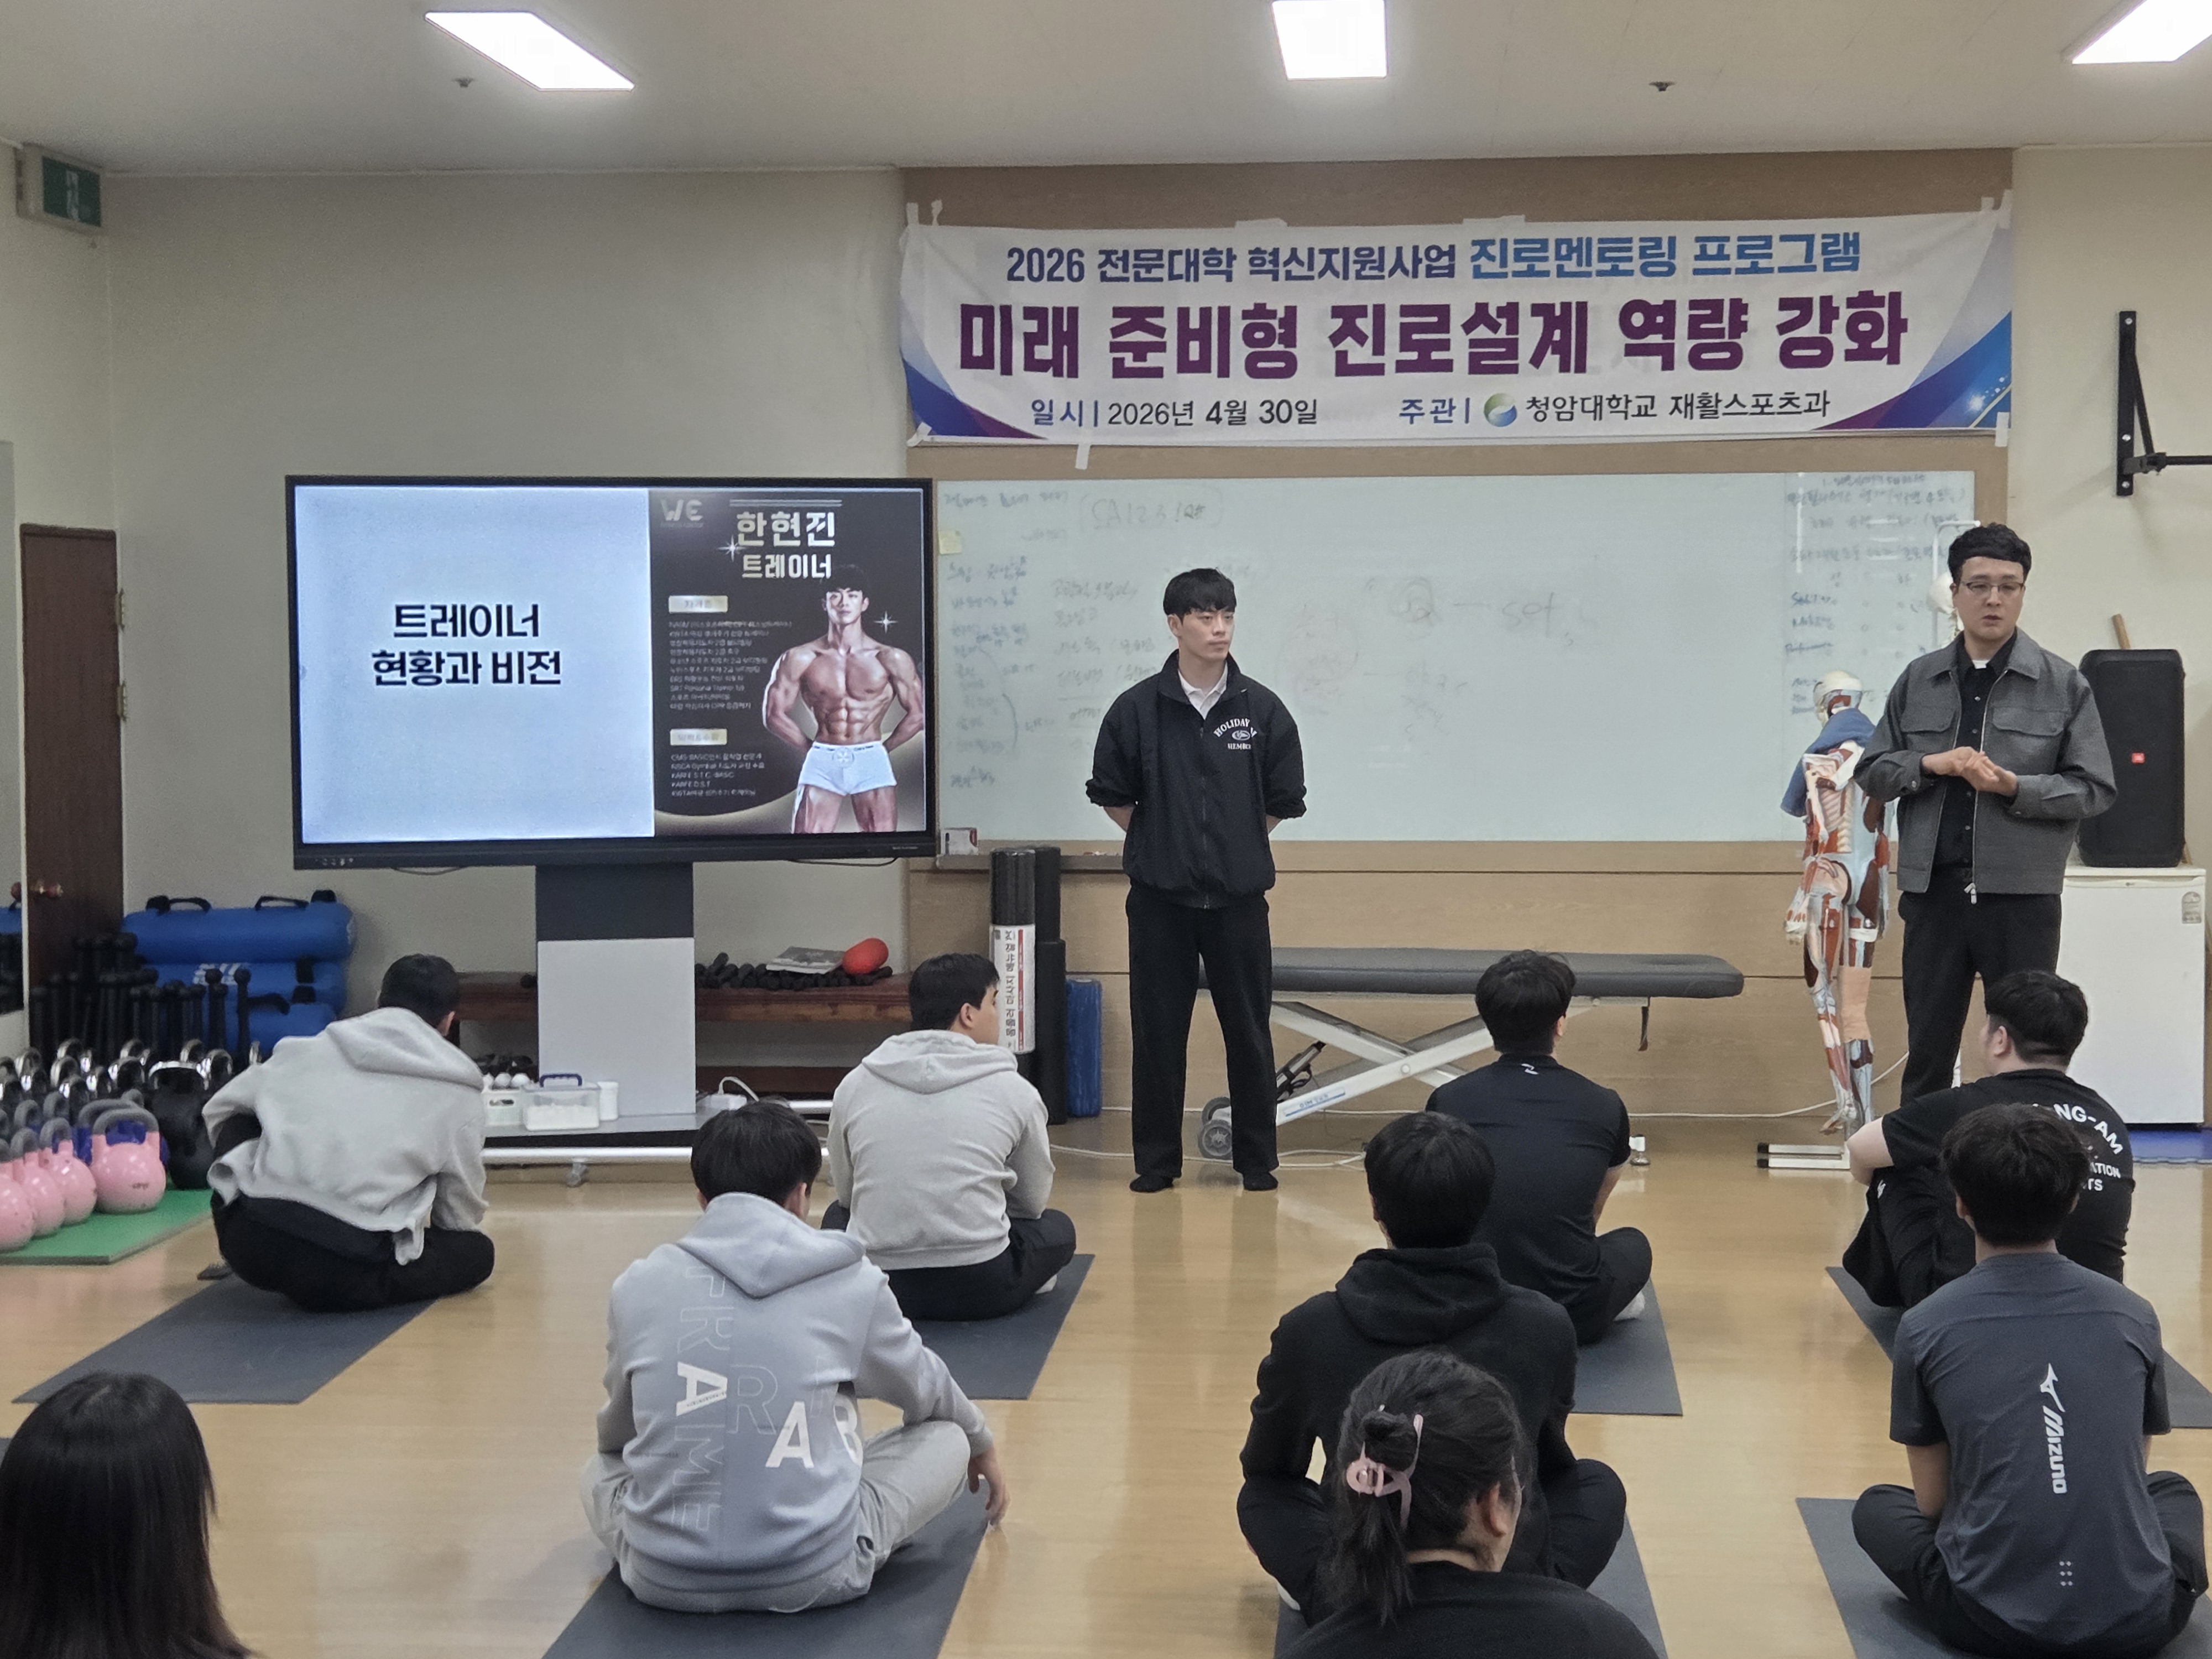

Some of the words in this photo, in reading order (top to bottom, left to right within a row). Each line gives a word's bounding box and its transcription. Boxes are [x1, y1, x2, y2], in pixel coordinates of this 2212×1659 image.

[1006, 247, 1084, 283] 2026
[1098, 247, 1237, 283] 전문대학
[1248, 244, 1455, 282] 혁신지원사업
[1470, 234, 1677, 279] 진로멘토링
[1692, 231, 1860, 275] 프로그램
[960, 303, 1079, 378] 미래
[1109, 302, 1298, 379] 준비형
[1328, 300, 1588, 377] 진로설계
[1618, 298, 1749, 372] 역량
[1776, 290, 1908, 369] 강화
[1108, 400, 1194, 426] 2026년
[1205, 399, 1247, 426] 4월
[1259, 399, 1317, 425] 30일
[1526, 394, 1657, 422] 청암대학교
[1668, 389, 1831, 420] 재활스포츠과
[737, 511, 836, 547] 한현진
[742, 554, 831, 578] 트레이너
[393, 603, 539, 638] 트레이너
[371, 649, 482, 686] 현황과
[492, 650, 561, 685] 비전
[1213, 718, 1250, 738] HOLIDAY
[2053, 1103, 2124, 1155] NG-AM
